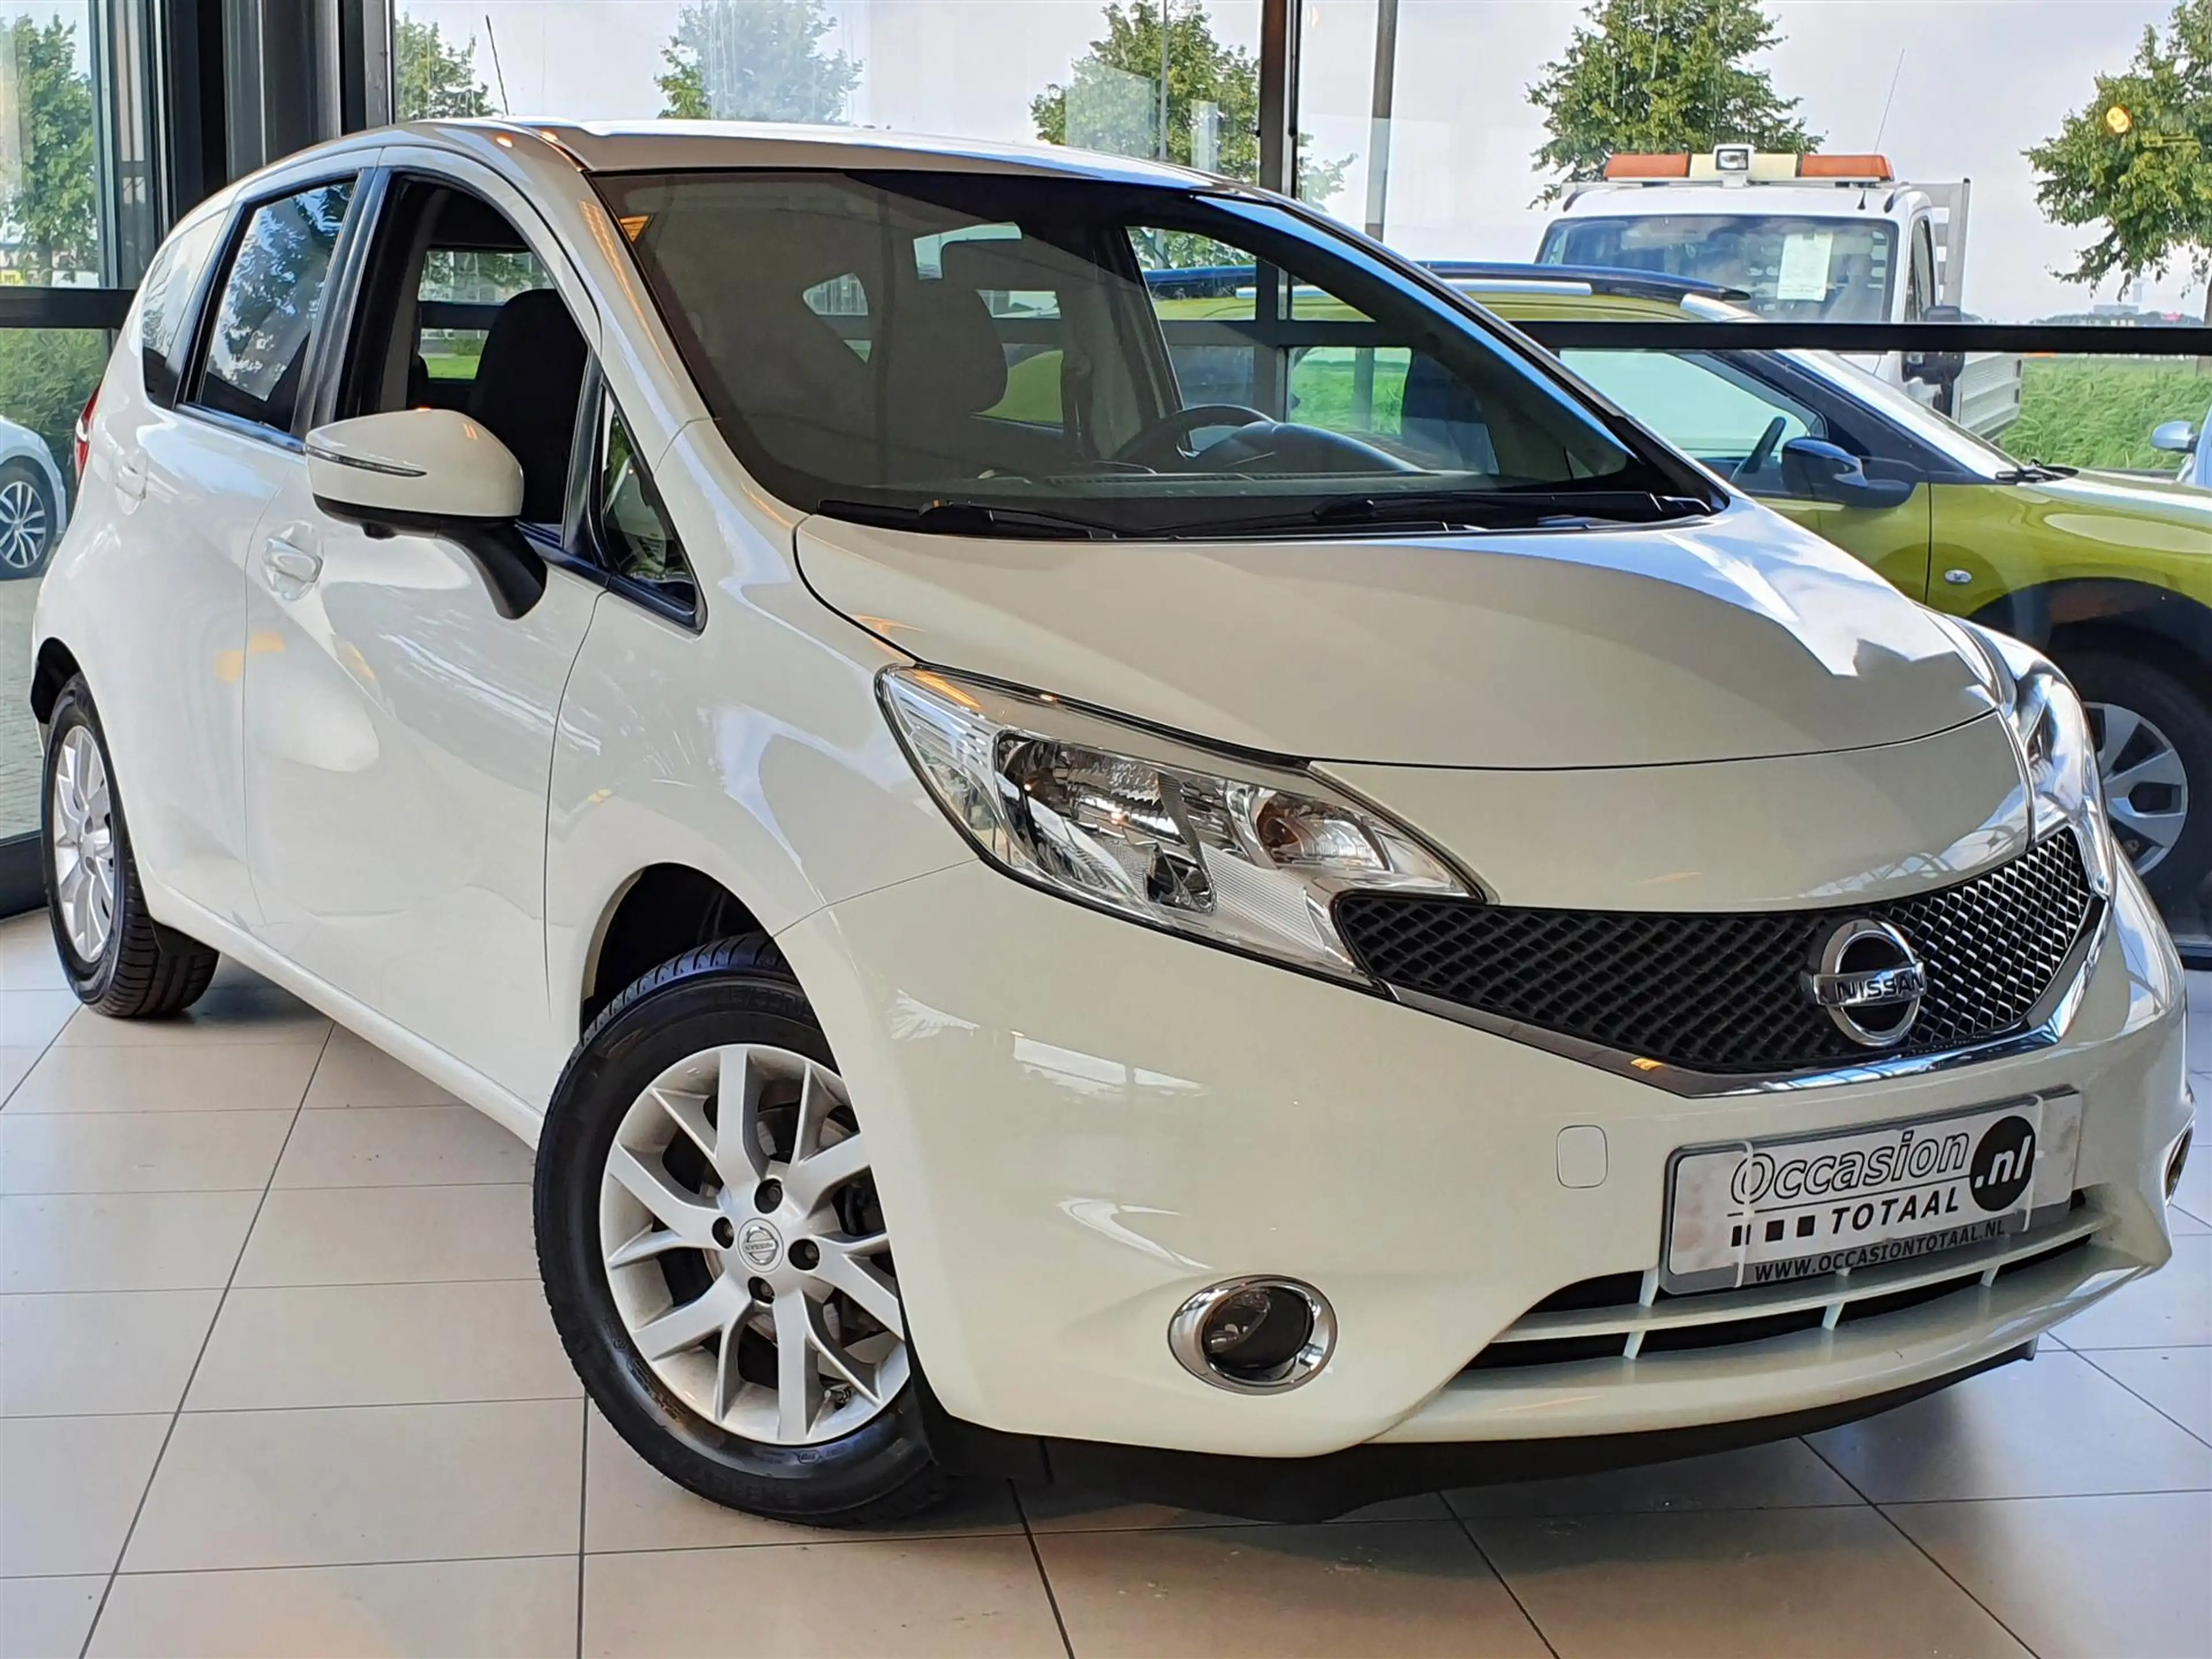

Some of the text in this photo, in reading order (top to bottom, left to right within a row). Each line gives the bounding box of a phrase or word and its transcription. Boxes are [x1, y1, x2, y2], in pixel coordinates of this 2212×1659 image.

[1836, 971, 1923, 1000] NISSAN
[1730, 1130, 1970, 1205] Occasion
[1832, 1187, 1959, 1234] TOTAAL
[1756, 1219, 2005, 1282] WWW.OCCASIONTOTAAL.NL
